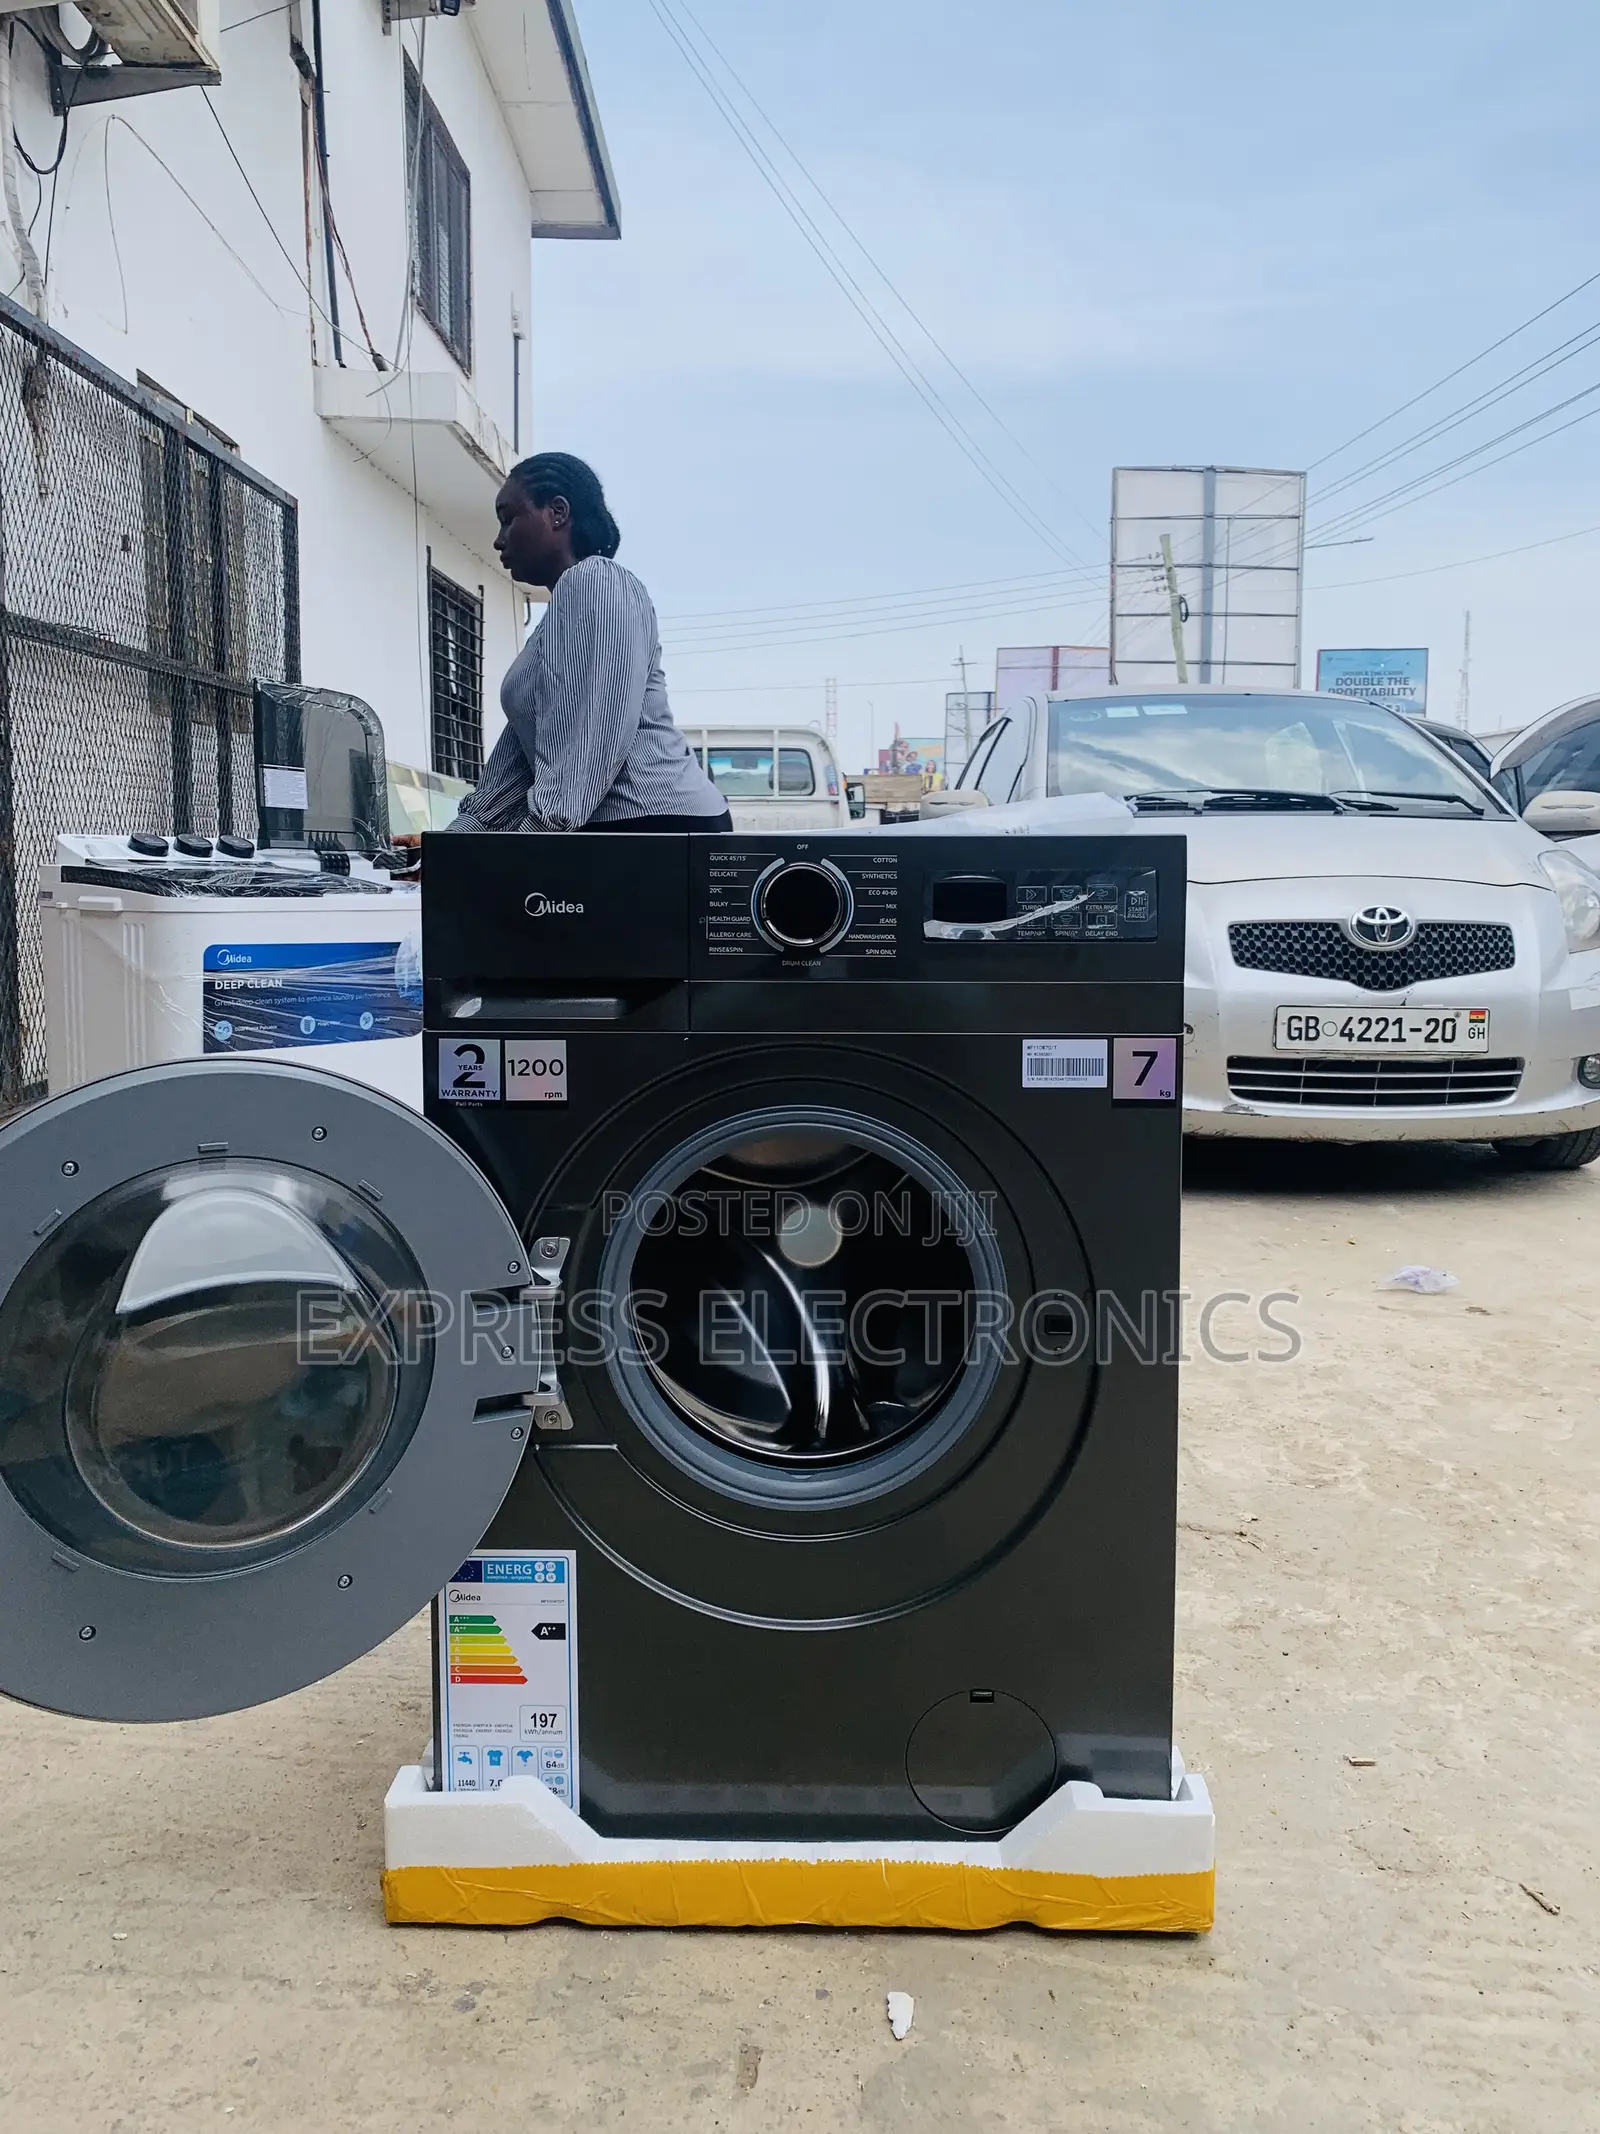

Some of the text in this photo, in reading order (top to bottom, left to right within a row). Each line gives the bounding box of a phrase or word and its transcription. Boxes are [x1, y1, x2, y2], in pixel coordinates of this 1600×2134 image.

[1335, 676, 1410, 686] DOUBLE THE
[528, 895, 584, 915] Midea
[220, 952, 252, 964] Midea
[214, 978, 283, 990] DEEP CLEAN
[274, 997, 297, 1005] system
[1287, 1016, 1457, 1044] GB 4221-20
[1468, 1027, 1485, 1040] GH
[453, 1044, 486, 1088] 2
[508, 1059, 564, 1076] 1200
[1132, 1051, 1158, 1086] 7
[441, 1089, 498, 1098] WARRANTY
[544, 1091, 562, 1099] rpm
[1160, 1090, 1171, 1098] kg
[487, 1564, 532, 1575] ENERG
[451, 1592, 481, 1602] Midea
[540, 1626, 556, 1636] A++
[530, 1713, 558, 1728] 197
